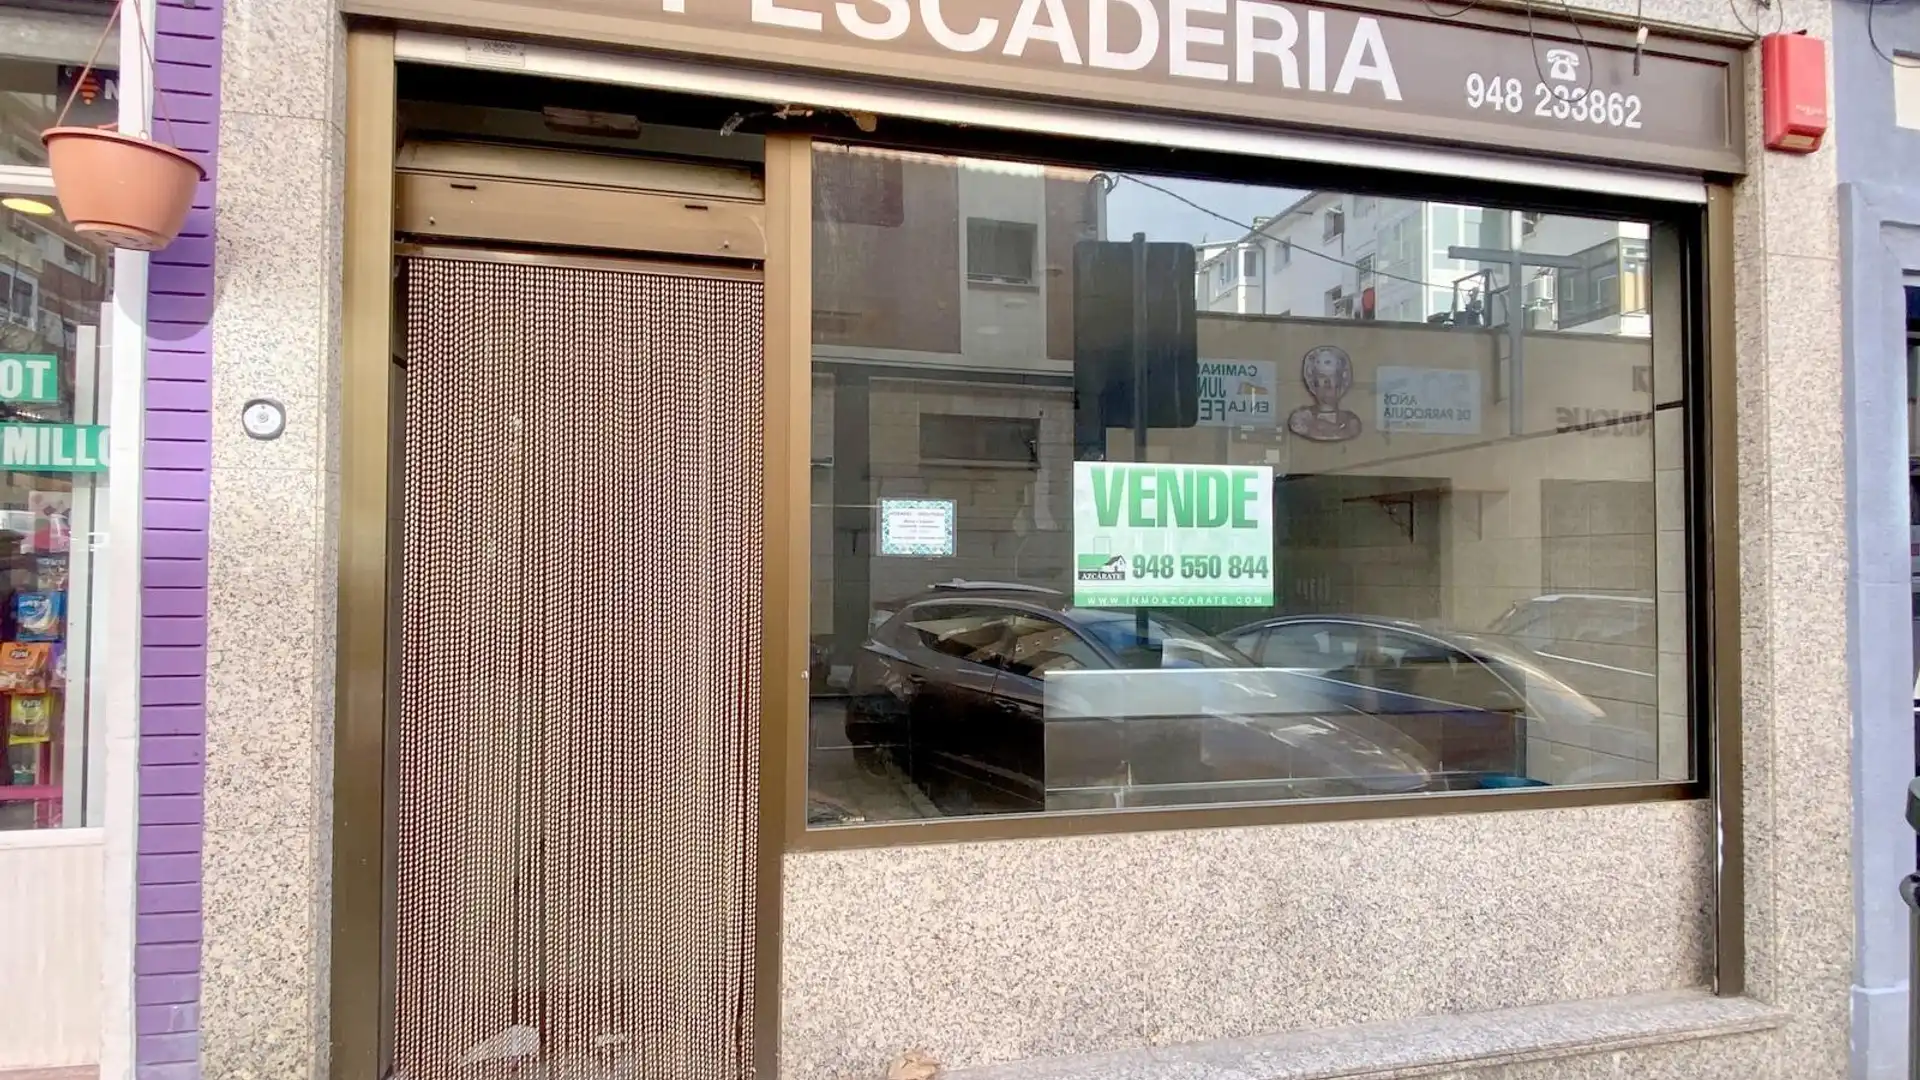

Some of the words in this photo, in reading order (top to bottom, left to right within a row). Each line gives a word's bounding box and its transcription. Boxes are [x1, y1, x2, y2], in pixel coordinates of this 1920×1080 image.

[662, 0, 1403, 100] CADERIA
[1466, 72, 1523, 113] 948
[1534, 82, 1643, 129] 233862
[1090, 466, 1259, 529] VENDE
[1082, 572, 1122, 580] AZCARATE
[1132, 554, 1174, 579] 948
[1180, 554, 1222, 579] 550
[1228, 554, 1269, 580] 844
